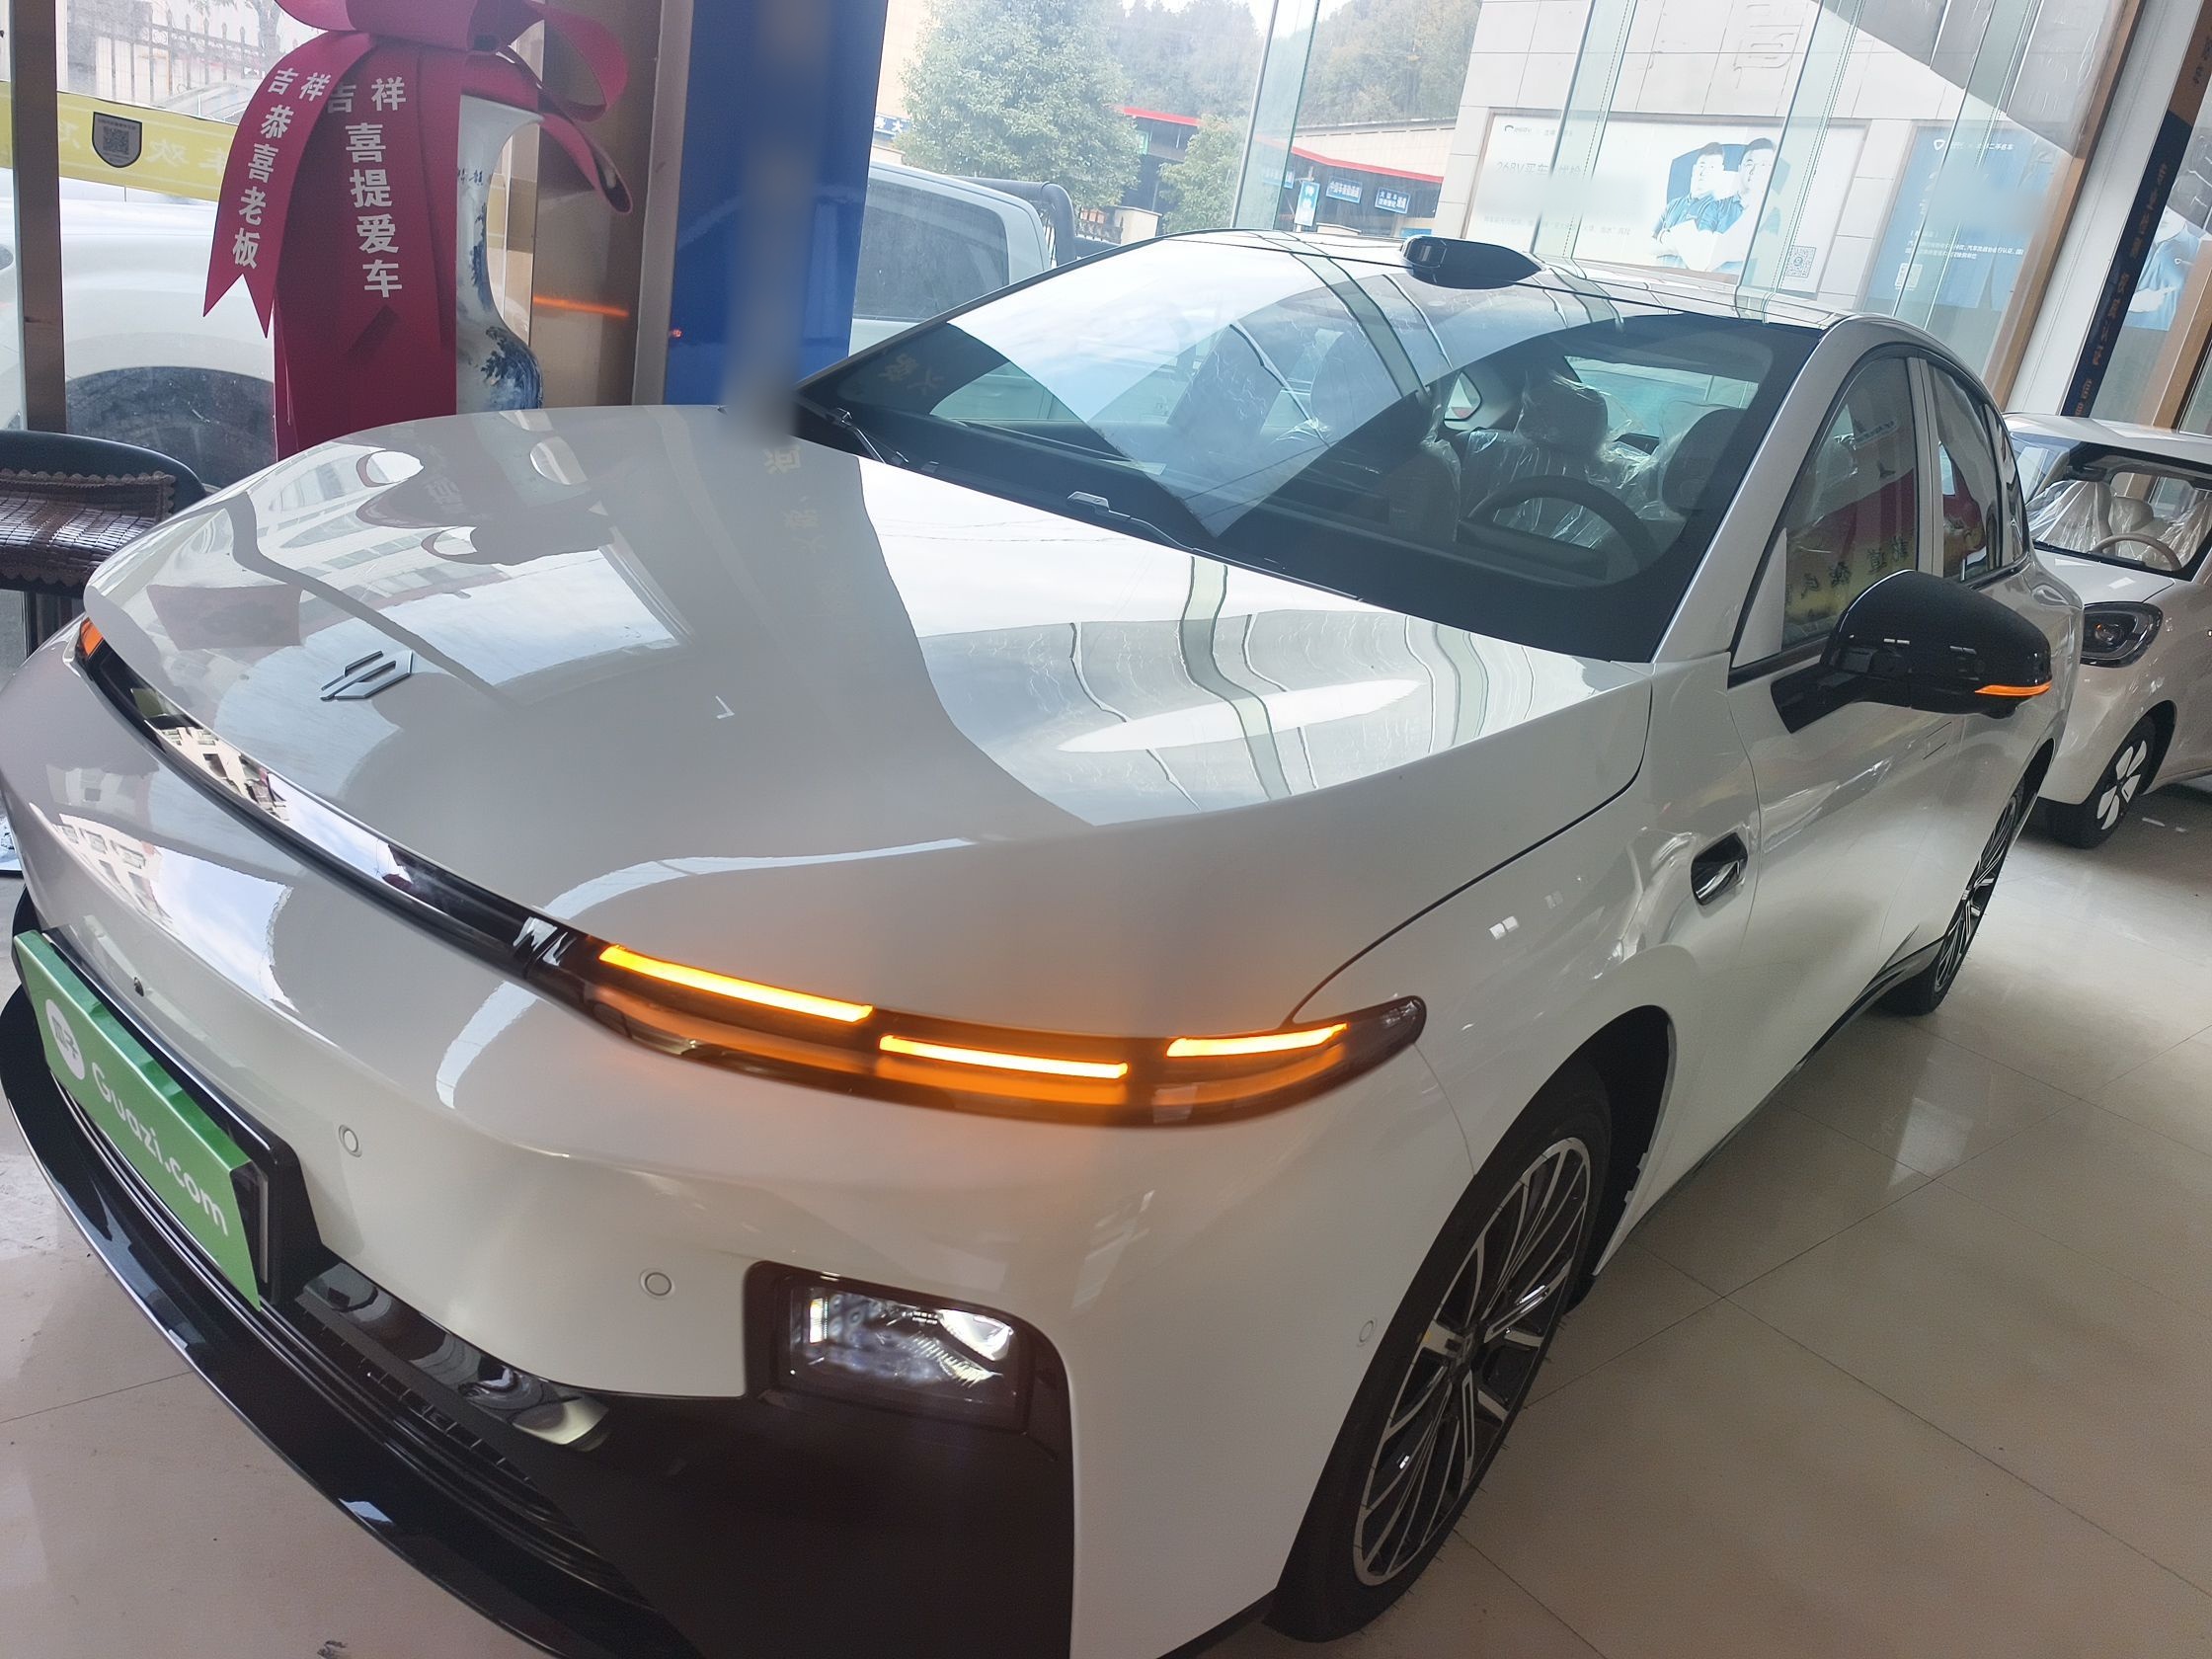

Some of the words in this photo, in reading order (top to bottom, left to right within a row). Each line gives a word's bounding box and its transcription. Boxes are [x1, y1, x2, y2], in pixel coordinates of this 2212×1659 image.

[268, 67, 332, 102] 吉祥
[327, 76, 407, 115] 吉祥
[232, 104, 294, 269] 恭喜老板
[345, 122, 403, 298] 喜提爱车
[91, 1061, 229, 1237] Guazi.com
